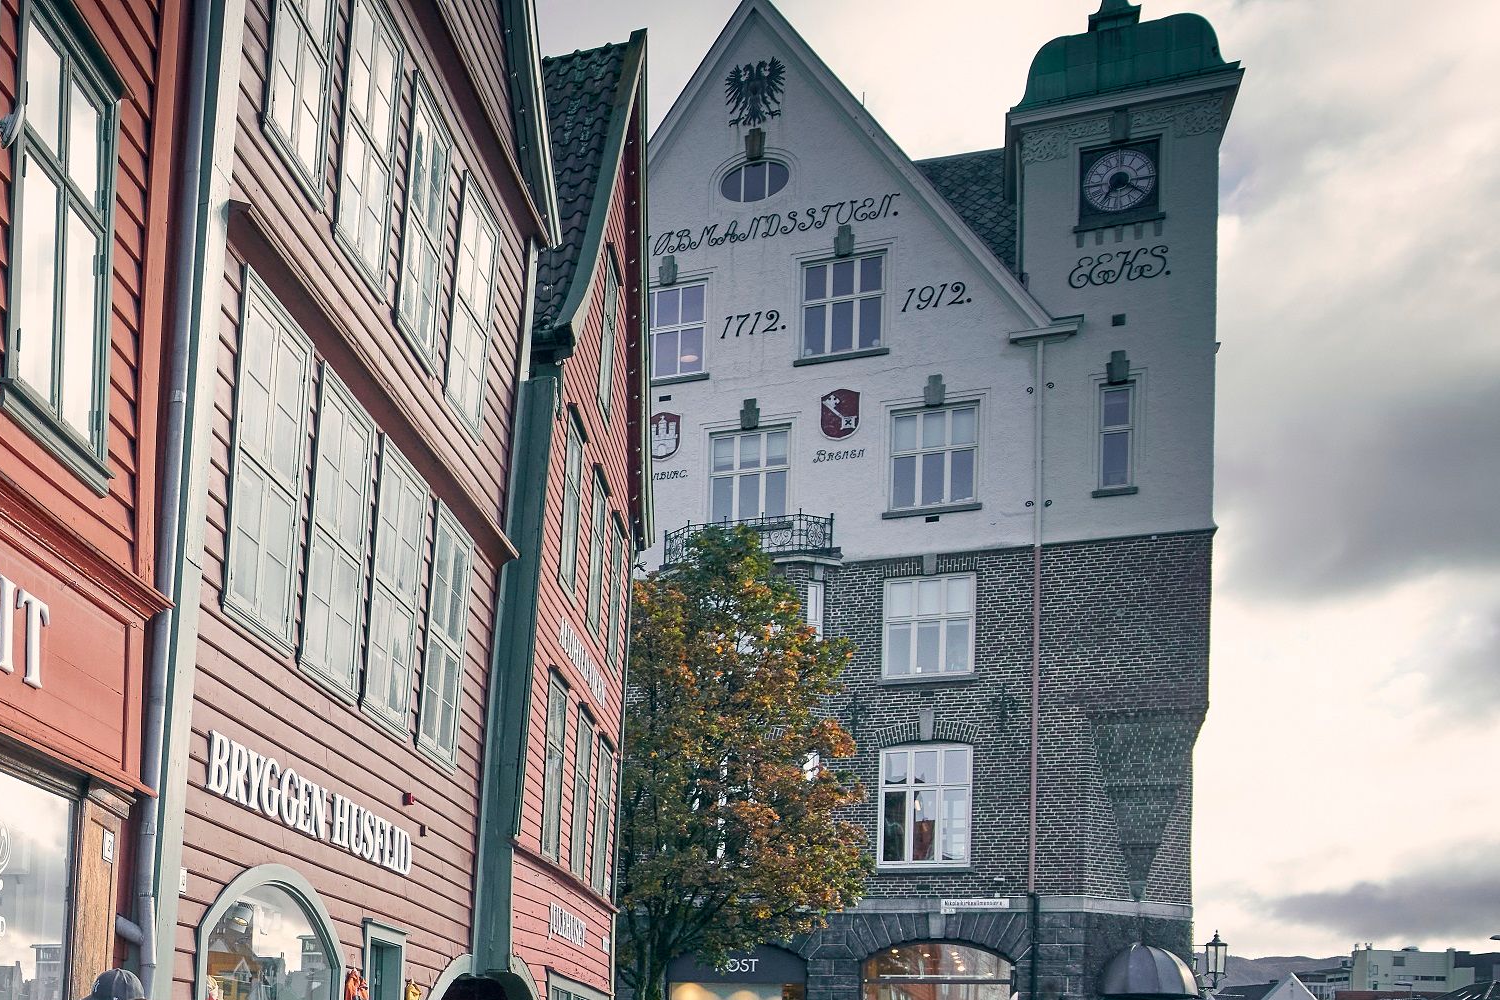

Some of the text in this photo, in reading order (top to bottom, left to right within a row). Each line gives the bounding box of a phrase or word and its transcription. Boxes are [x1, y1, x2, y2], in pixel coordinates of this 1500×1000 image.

[647, 192, 901, 257] ØBMANDSSTUEN.
[206, 729, 413, 876] BRYGGEN HUSFLID
[547, 901, 587, 949] JULEHUSET
